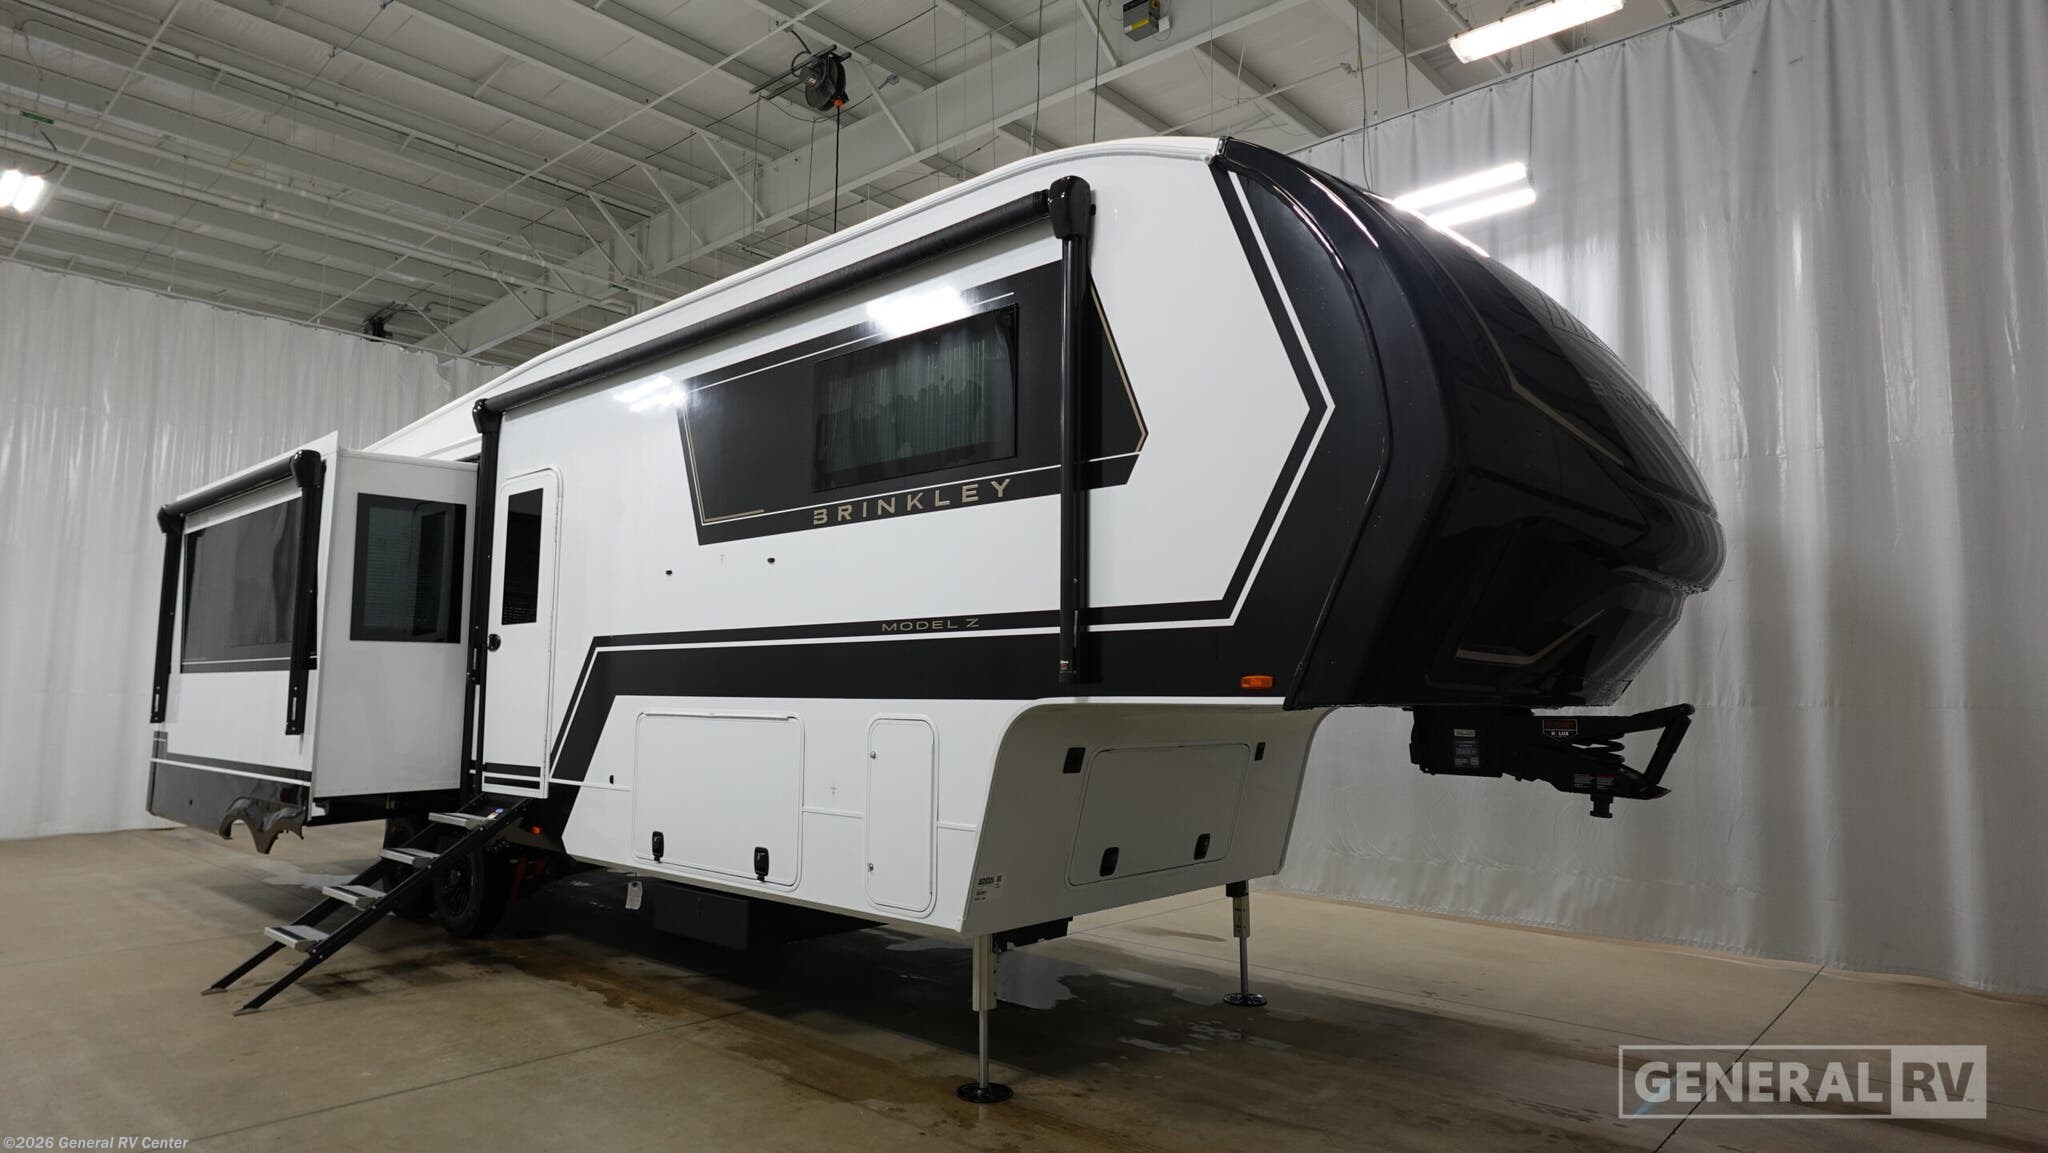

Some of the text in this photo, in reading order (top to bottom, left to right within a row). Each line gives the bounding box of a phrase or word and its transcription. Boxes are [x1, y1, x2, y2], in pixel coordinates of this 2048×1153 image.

[813, 478, 1011, 525] BRINKLEY
[881, 617, 980, 632] MODEL Z
